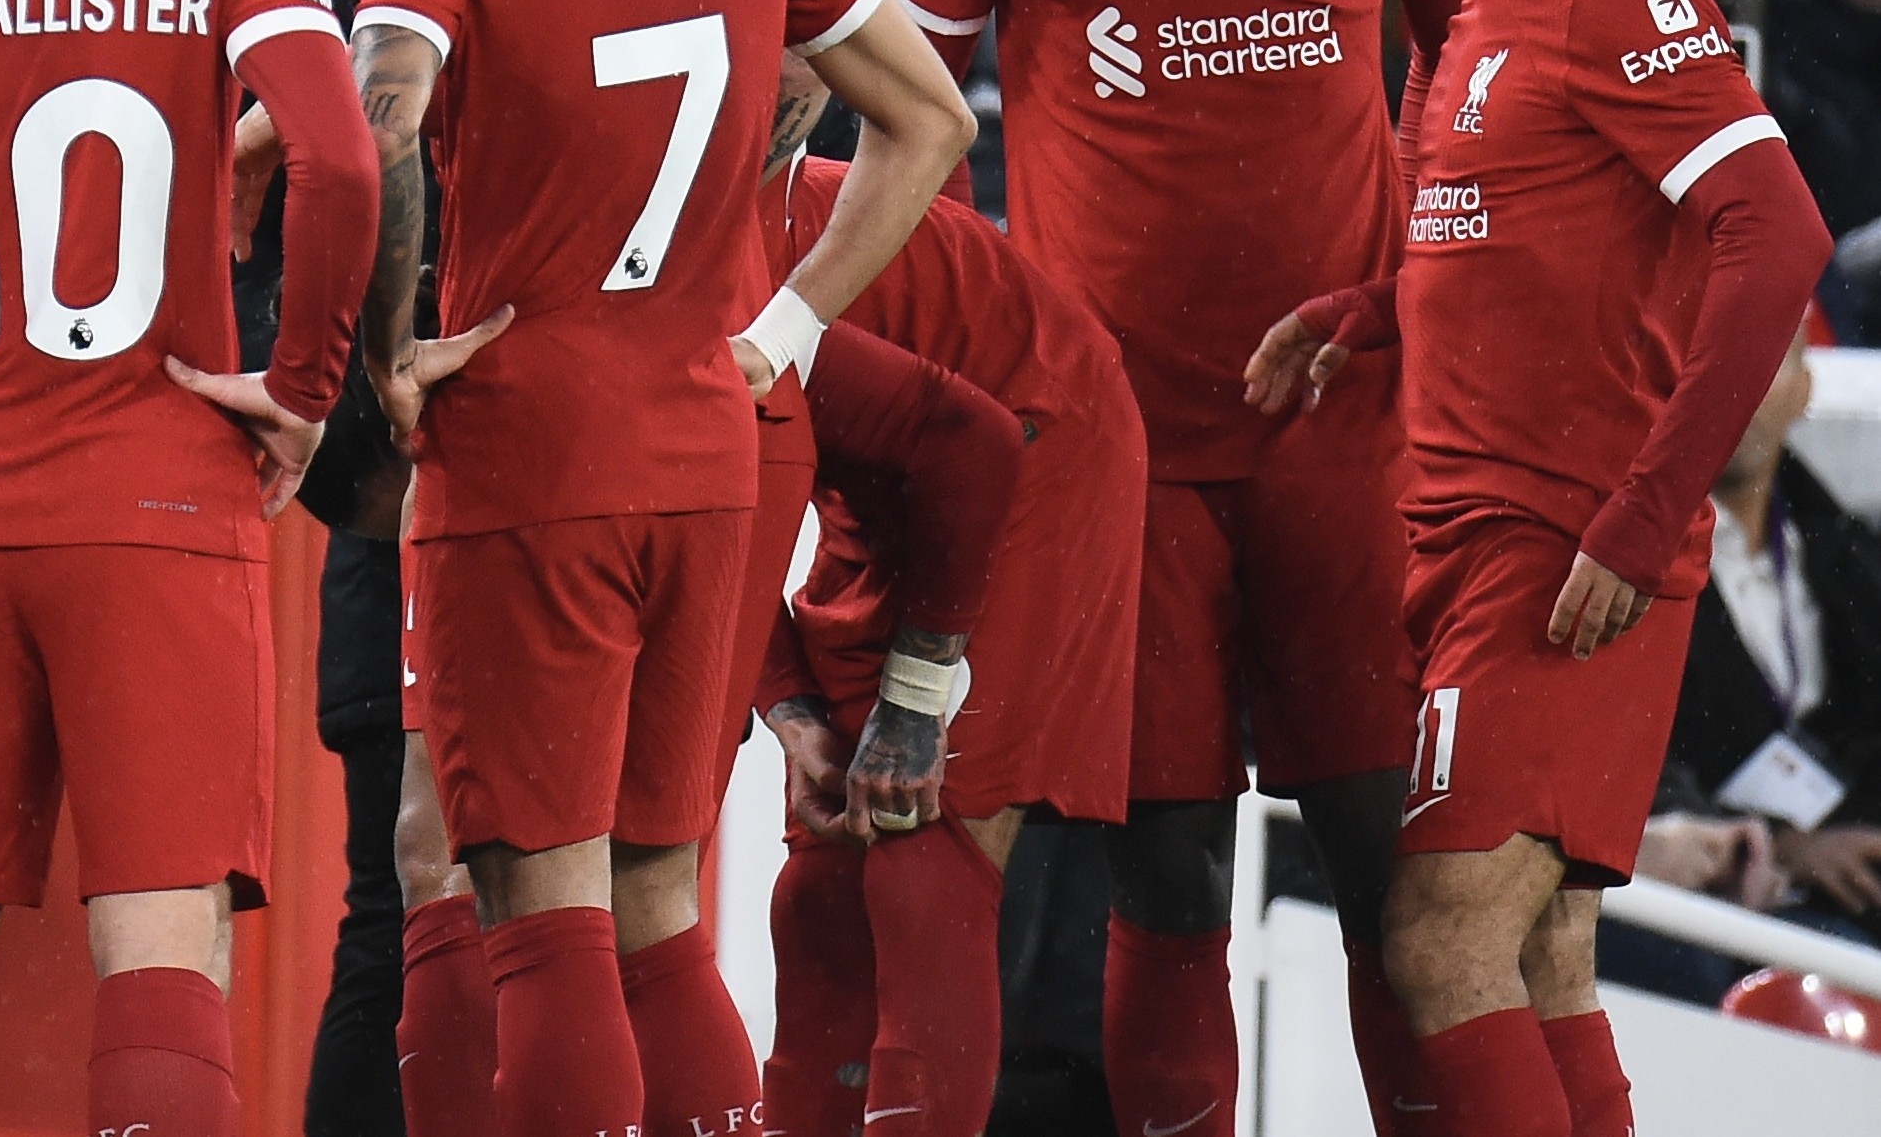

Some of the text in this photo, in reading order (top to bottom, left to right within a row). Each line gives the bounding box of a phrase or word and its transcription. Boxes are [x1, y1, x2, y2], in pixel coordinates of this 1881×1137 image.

[1157, 4, 1332, 49] standard
[1161, 30, 1343, 80] chartered
[592, 13, 730, 291] 7
[1413, 180, 1481, 214] tandard
[1408, 209, 1488, 243] hartered
